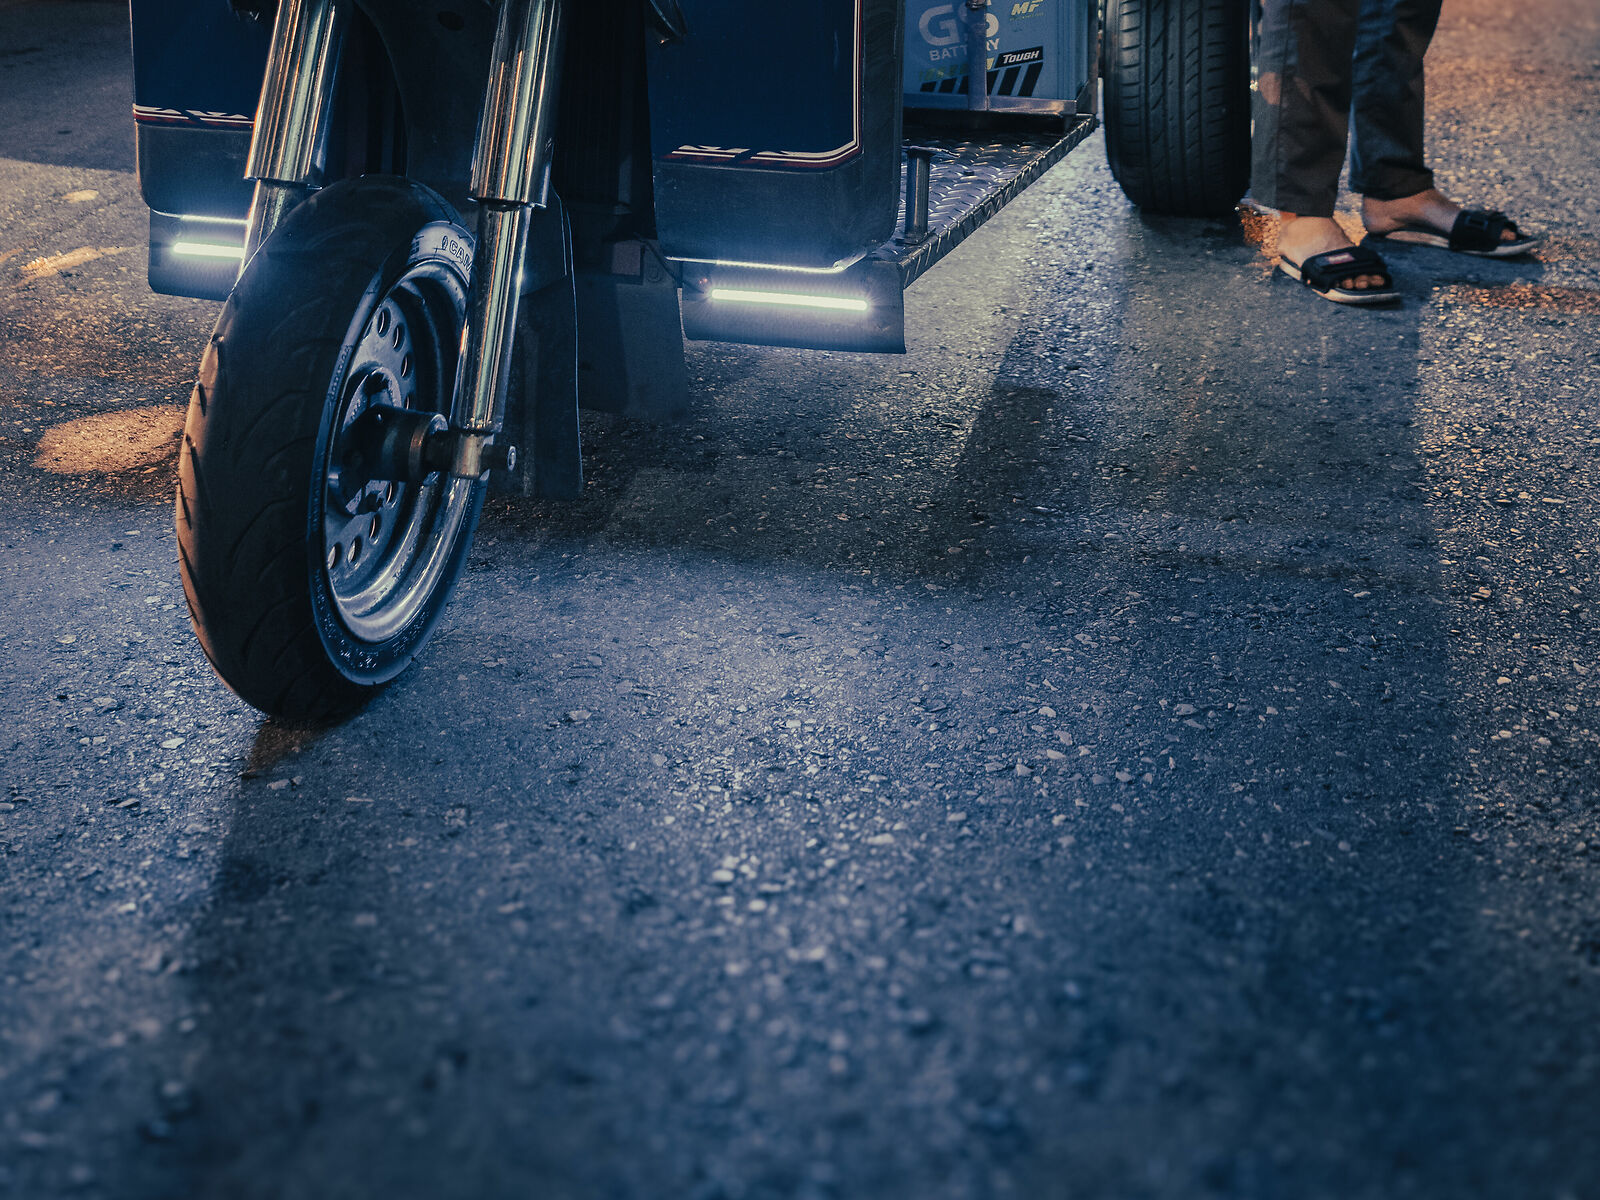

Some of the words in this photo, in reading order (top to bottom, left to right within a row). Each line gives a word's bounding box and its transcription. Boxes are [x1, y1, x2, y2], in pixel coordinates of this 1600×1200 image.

[1010, 0, 1044, 16] MF
[929, 38, 1001, 62] BATTRY
[1002, 50, 1040, 64] TOUGH
